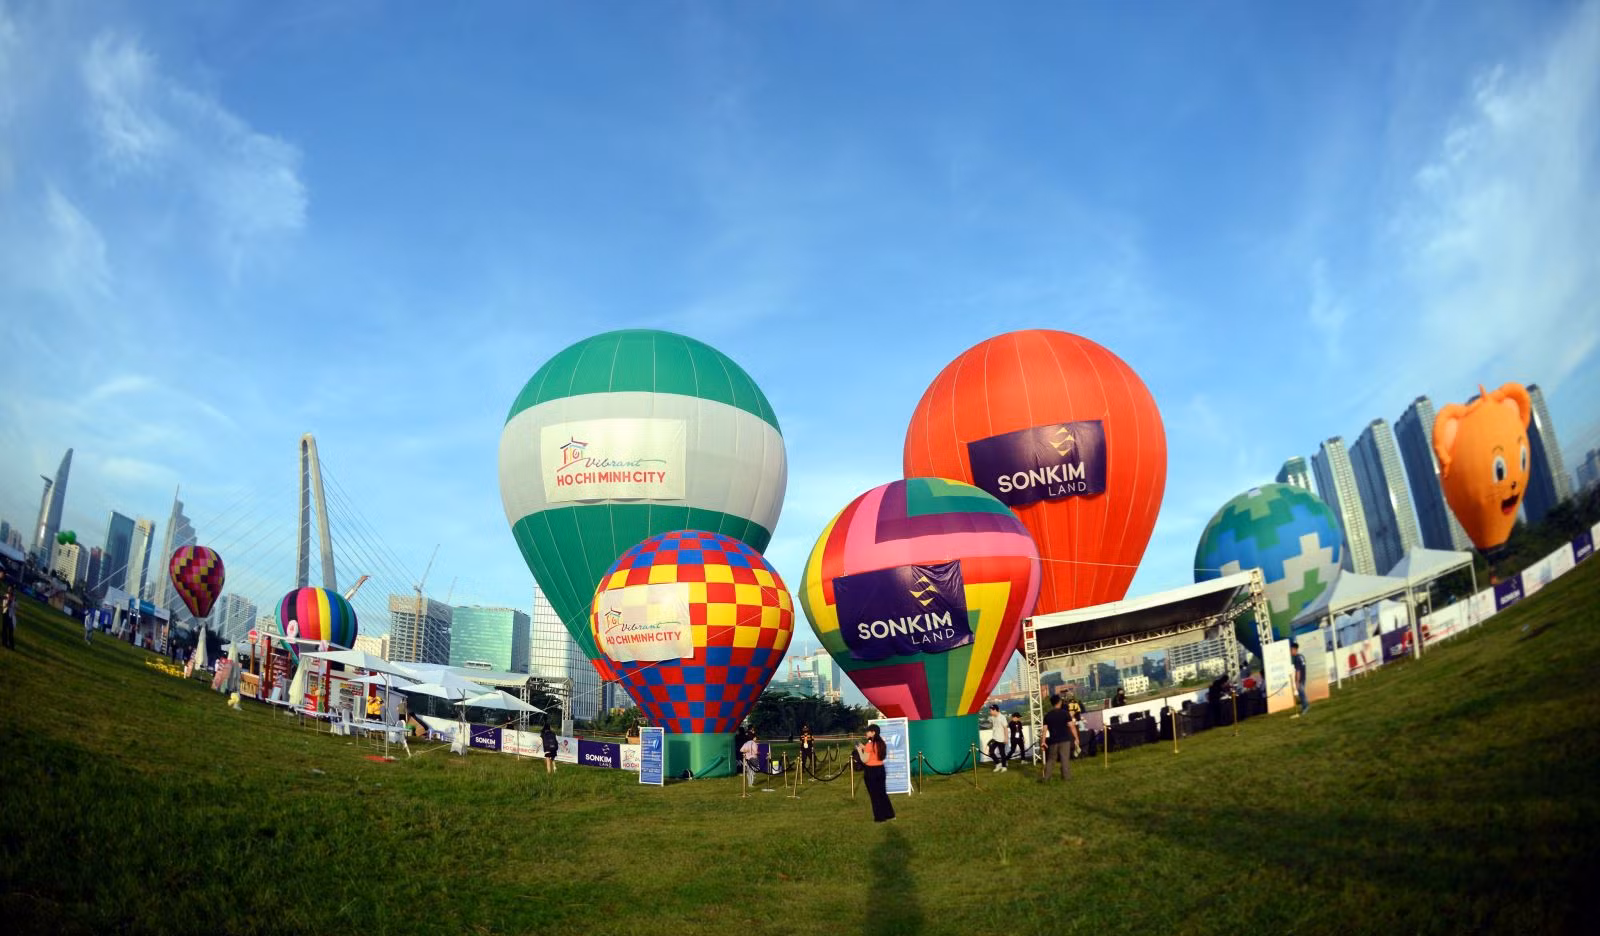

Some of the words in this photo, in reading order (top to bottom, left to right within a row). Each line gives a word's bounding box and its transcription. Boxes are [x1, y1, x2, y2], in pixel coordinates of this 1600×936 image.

[585, 457, 666, 468] Vibrant
[557, 474, 573, 487] HO
[575, 472, 596, 485] CHI
[598, 471, 631, 484] MINH
[633, 471, 666, 483] CITY
[997, 461, 1086, 493] SONKIM
[1048, 481, 1087, 497] LAND
[621, 621, 681, 632] Vibrant
[857, 610, 953, 640] SONKIM
[615, 635, 631, 645] CHI
[630, 633, 655, 644] MINH
[655, 631, 682, 642] CITY
[911, 628, 955, 645] LAND
[475, 736, 496, 746] SONKIM
[585, 753, 612, 764] SONKIM
